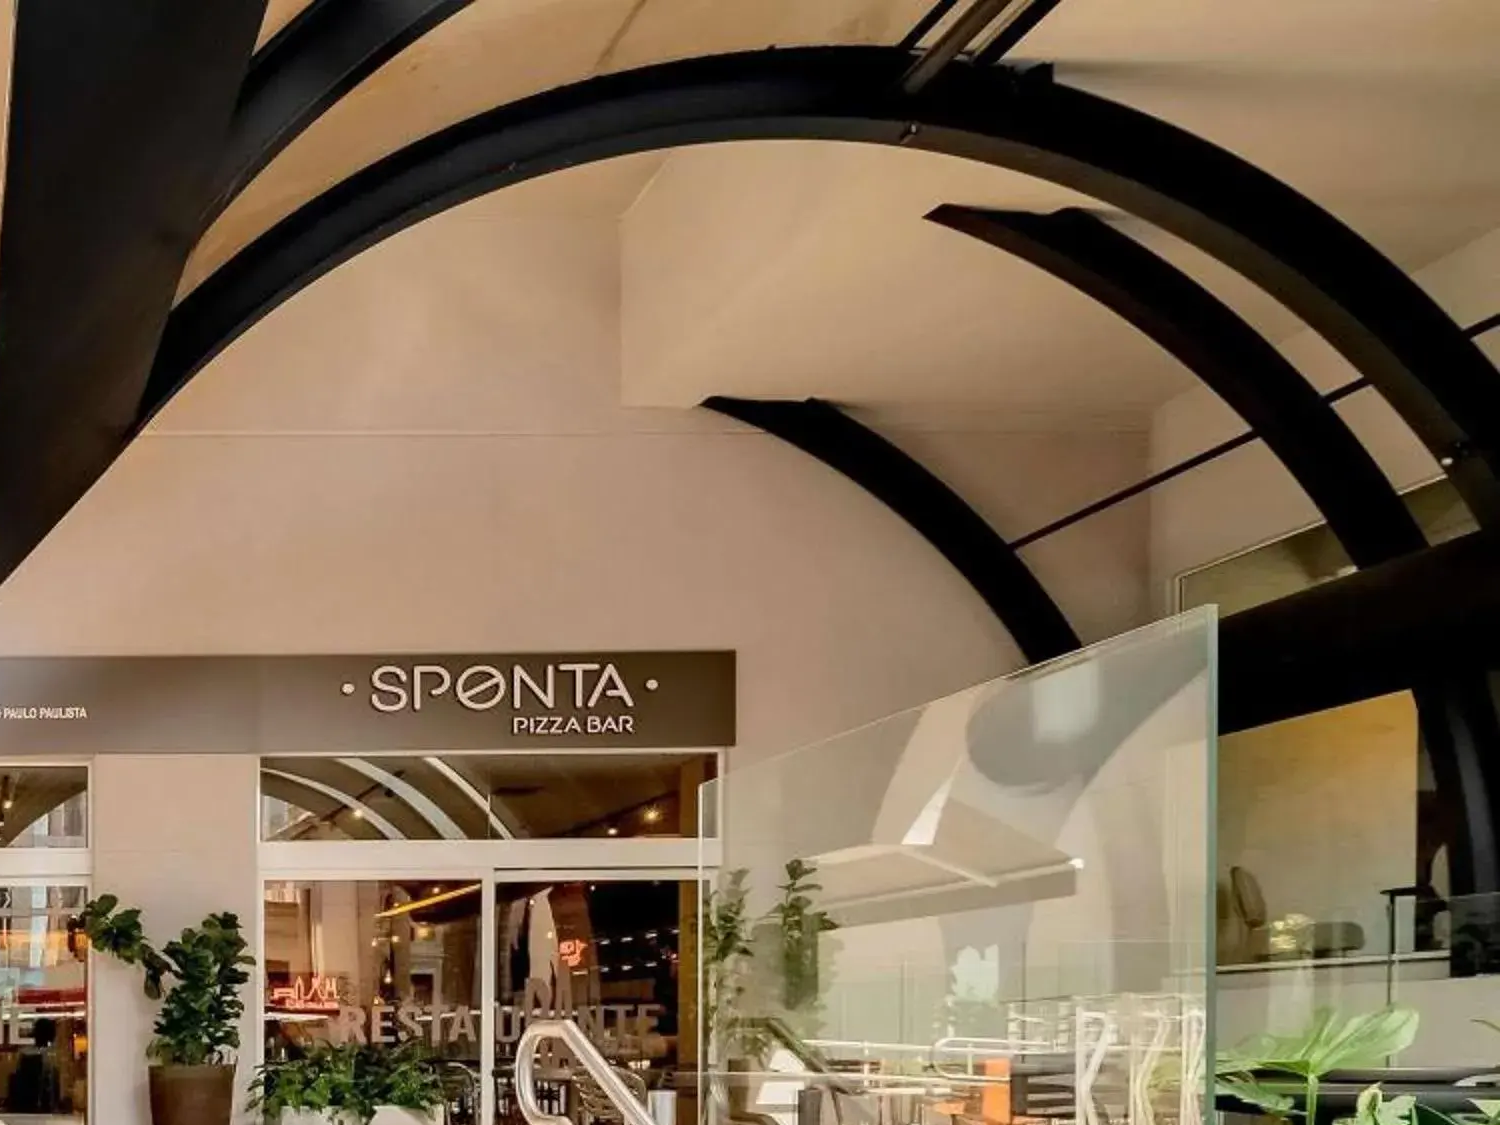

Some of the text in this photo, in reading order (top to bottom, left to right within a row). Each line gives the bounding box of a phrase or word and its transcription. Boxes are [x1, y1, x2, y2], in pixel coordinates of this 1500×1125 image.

[3, 706, 37, 720] PAULO
[38, 705, 88, 719] PAULISTA
[512, 715, 635, 735] PIZZA BAR
